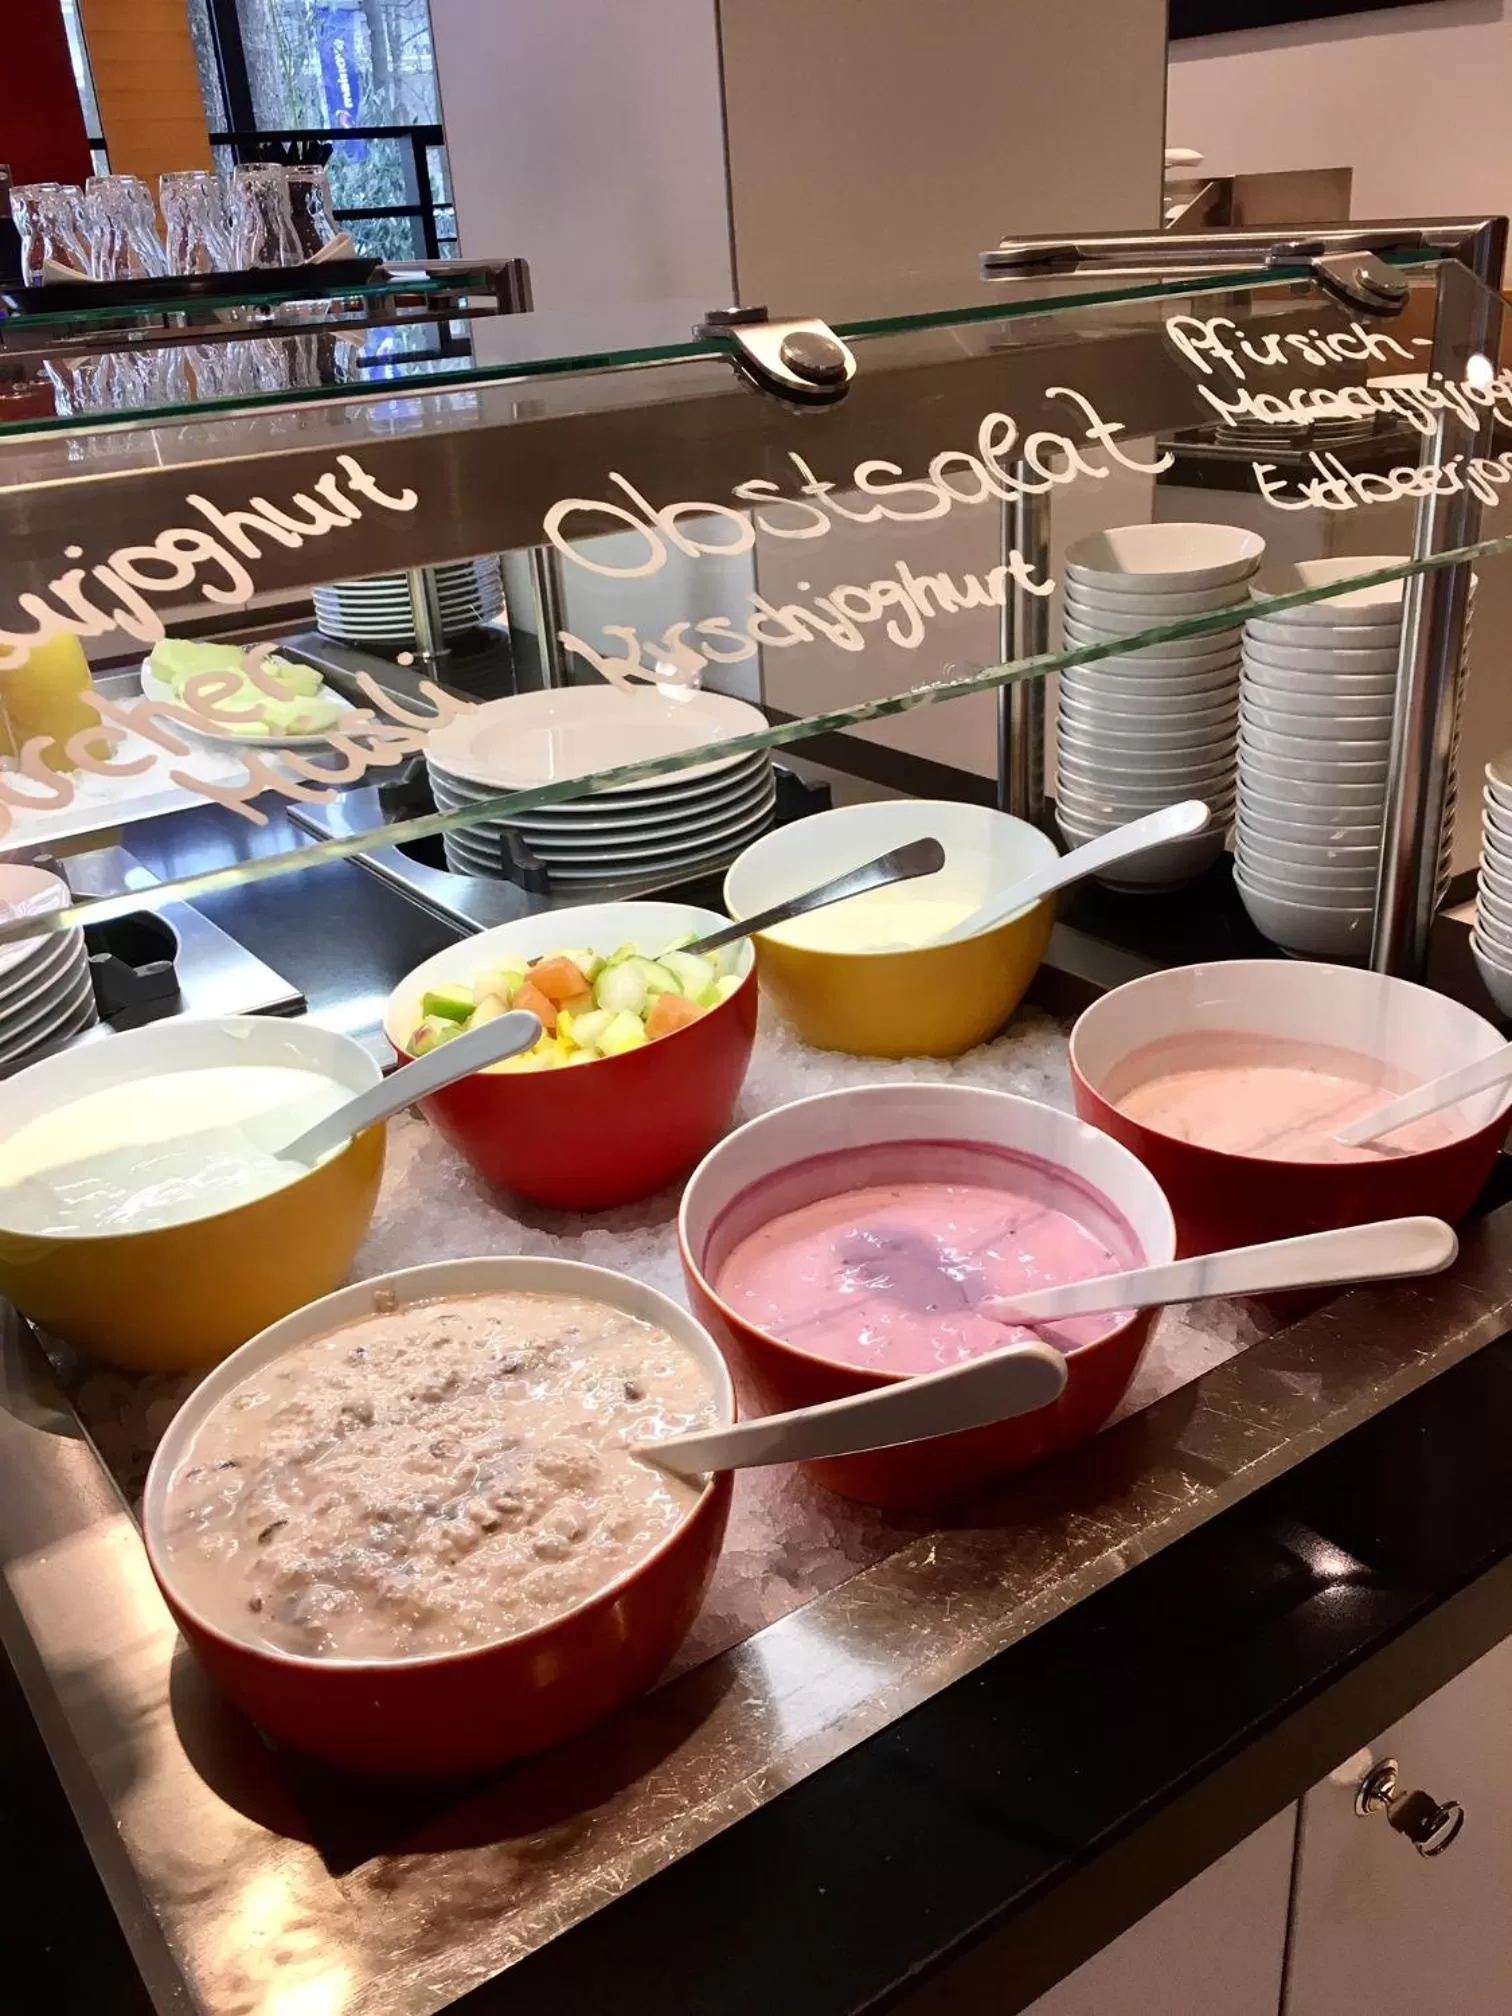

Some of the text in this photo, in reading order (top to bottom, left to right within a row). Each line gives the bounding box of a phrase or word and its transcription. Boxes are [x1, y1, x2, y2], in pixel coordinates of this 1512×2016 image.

[542, 386, 1175, 579] Obstsalat
[1198, 366, 1512, 436] Maracujajog
[0, 454, 419, 670] urjoghurt
